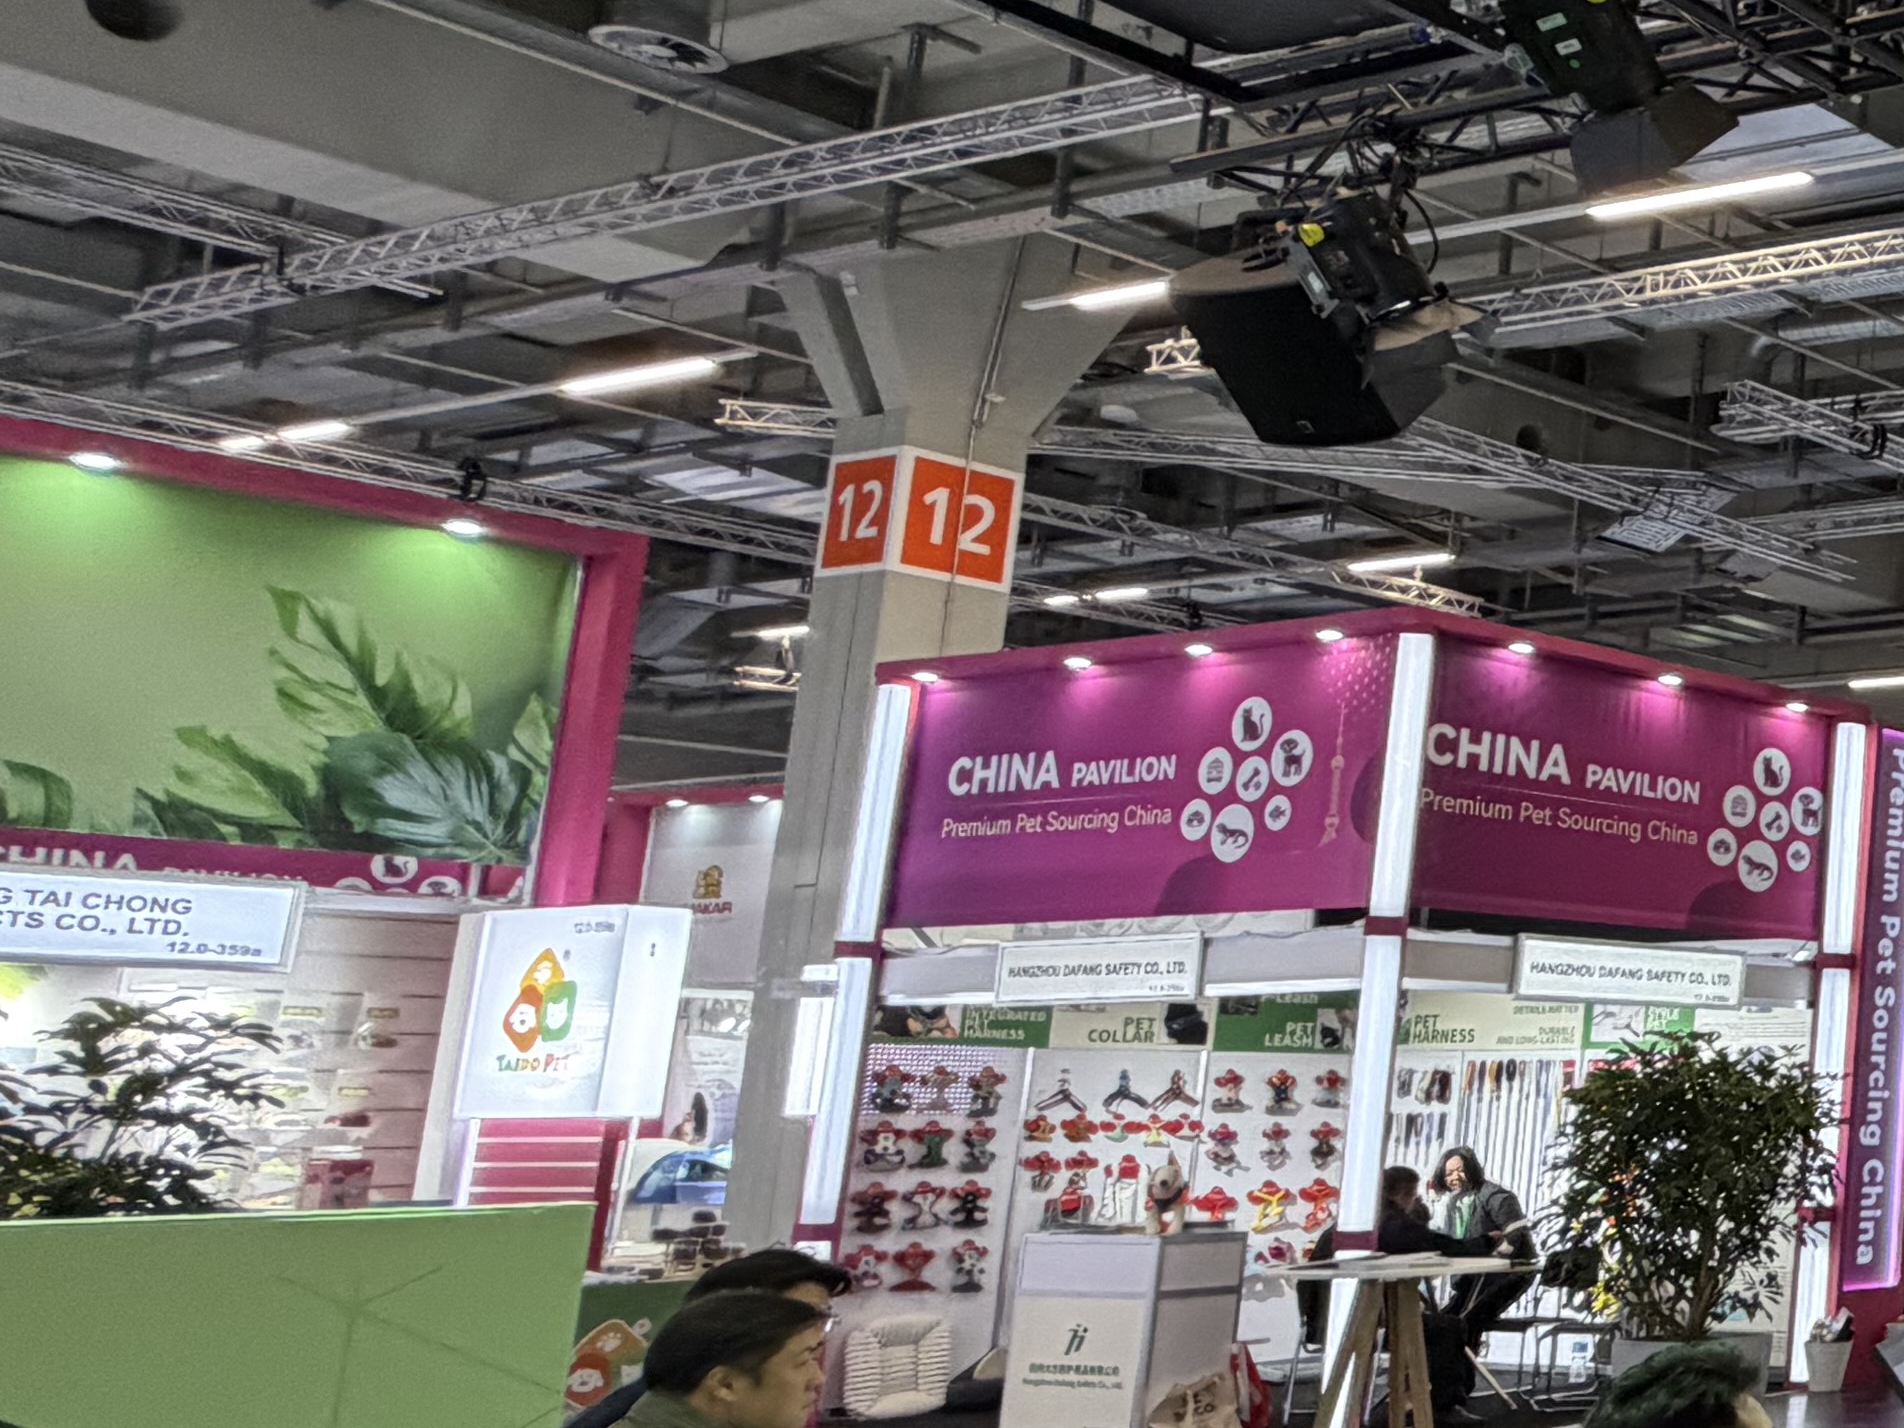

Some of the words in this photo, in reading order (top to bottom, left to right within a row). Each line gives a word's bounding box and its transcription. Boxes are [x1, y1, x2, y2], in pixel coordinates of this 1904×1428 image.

[838, 479, 883, 542] 12
[923, 486, 996, 557] 12
[948, 750, 1060, 797] CHINA
[1071, 754, 1177, 788] PAVILION
[1426, 722, 1571, 785] CHINA
[1585, 764, 1701, 805] PAVILION
[941, 815, 1012, 838] Premium
[1015, 813, 1043, 834] Pet
[1046, 808, 1119, 833] Sourcing
[1124, 804, 1172, 826] China
[1419, 787, 1513, 821] Premium
[1519, 801, 1553, 826] Pet
[1557, 806, 1642, 843] Sourcing
[1648, 819, 1698, 845] China
[0, 845, 138, 871] HINA
[24, 889, 72, 908] TAI
[81, 892, 192, 915] CHONG
[55, 913, 117, 935] CO.,
[127, 917, 190, 937] LTD.
[1876, 914, 1900, 975] Pet
[1105, 962, 1142, 976] SAFETY
[1530, 961, 1596, 977] HANGZHOU
[1646, 968, 1685, 983] SAFETY
[1123, 1017, 1157, 1030] PET
[1286, 1022, 1315, 1035] PET
[1413, 1014, 1440, 1028] PET
[1088, 1029, 1156, 1043] COLLAR
[1264, 1033, 1313, 1047] LEASH
[1412, 1028, 1475, 1044] HARNESS
[1859, 985, 1895, 1147] Sourcing
[1856, 1158, 1885, 1265] China
